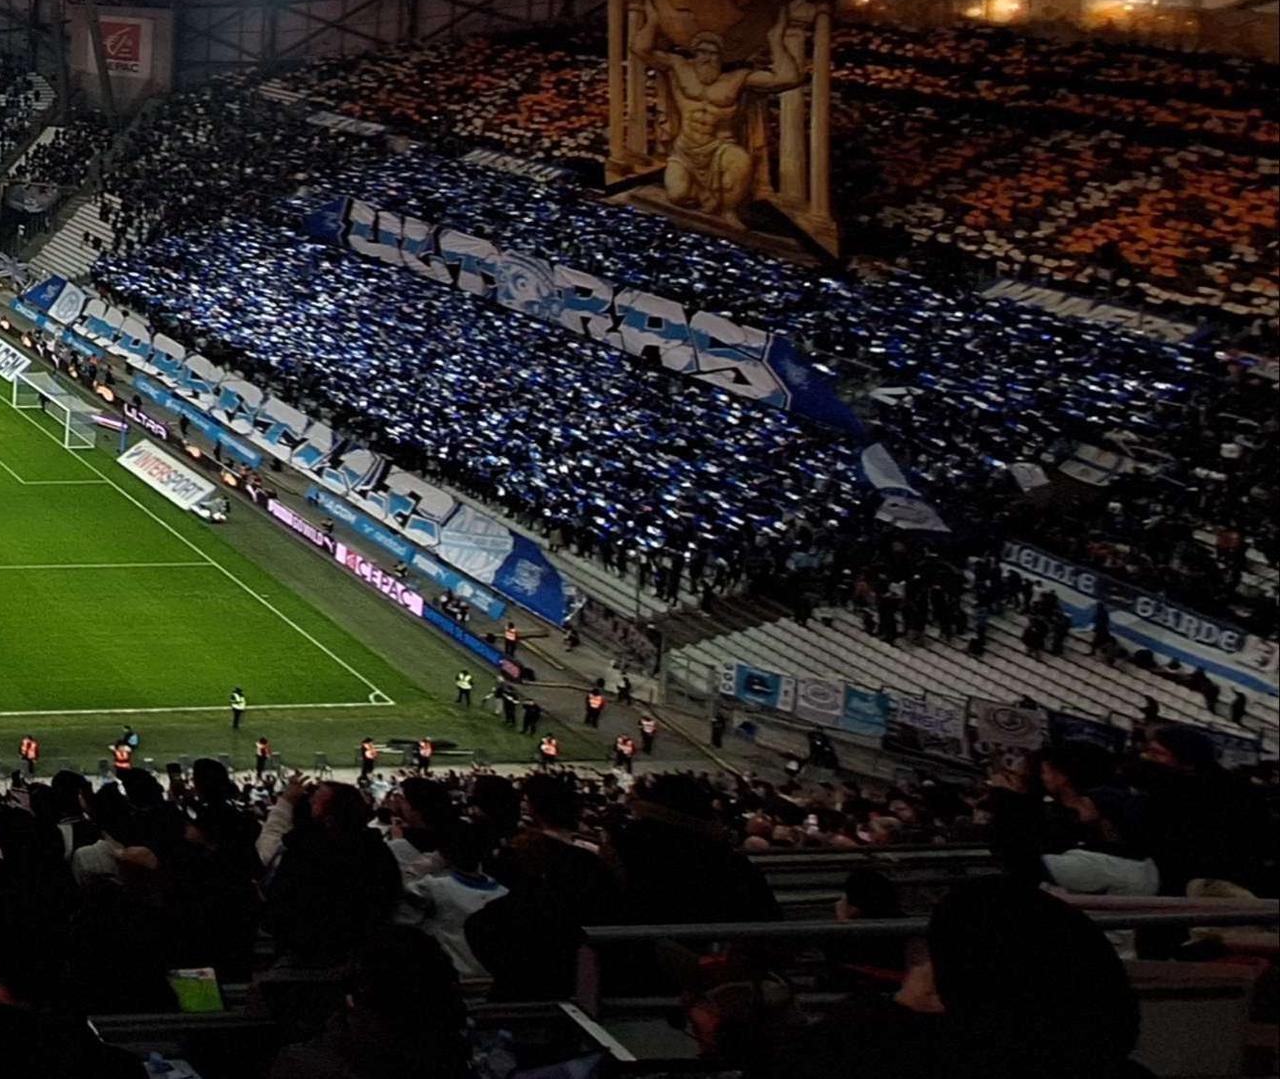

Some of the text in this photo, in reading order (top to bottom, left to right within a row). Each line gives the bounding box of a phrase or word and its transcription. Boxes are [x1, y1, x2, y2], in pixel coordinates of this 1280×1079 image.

[107, 62, 140, 73] EPAC
[123, 404, 168, 439] ULTRA
[133, 450, 205, 503] INTERSPORT
[355, 561, 417, 608] CEPAC
[1136, 595, 1241, 652] GARDE
